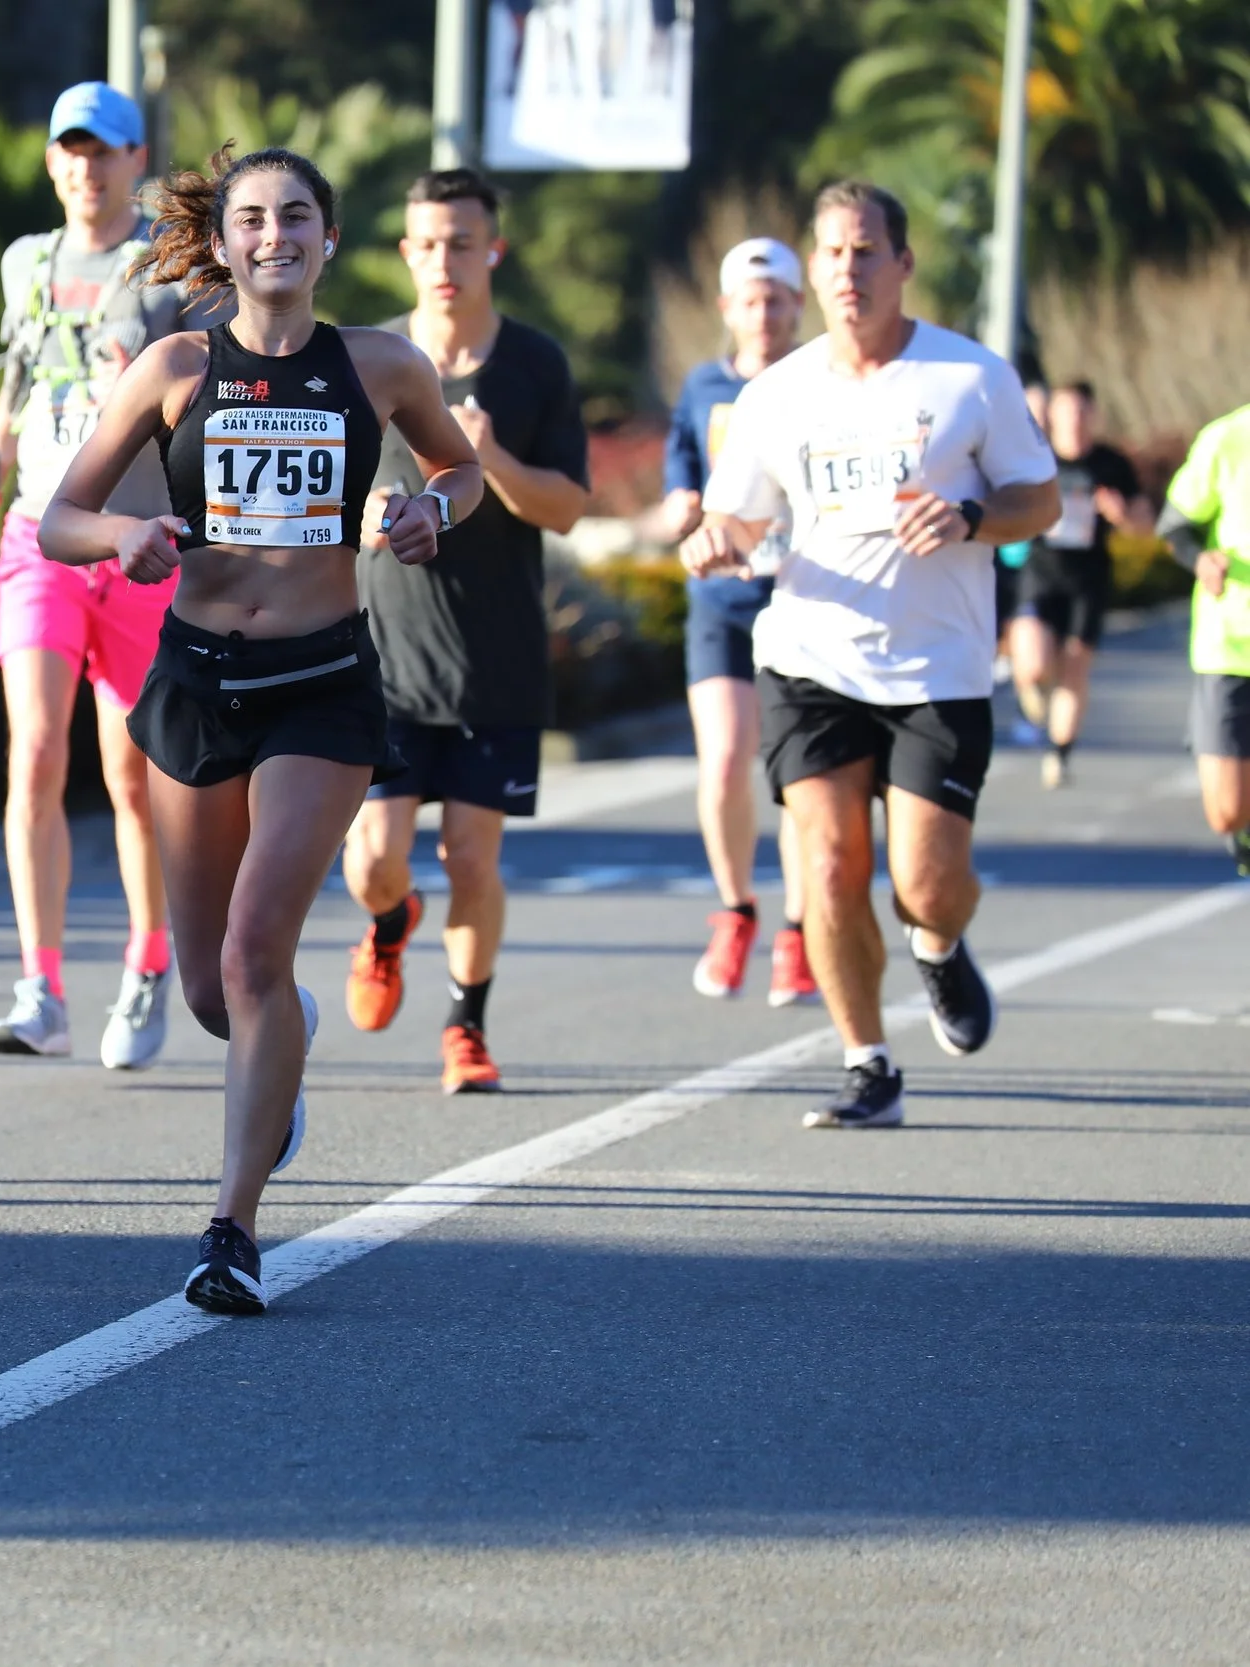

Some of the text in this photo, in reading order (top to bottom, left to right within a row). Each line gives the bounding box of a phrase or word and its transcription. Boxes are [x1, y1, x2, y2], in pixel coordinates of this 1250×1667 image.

[218, 380, 248, 392] WEST
[217, 390, 254, 401] VALLEY
[223, 410, 327, 421] 2022 KAISER PERMANENTE
[222, 419, 328, 432] SAN FRANCISCO
[217, 448, 333, 496] 1759
[824, 450, 909, 493] 1593
[226, 526, 242, 536] GEAR
[243, 527, 262, 537] CHECK
[302, 528, 331, 544] 1759
